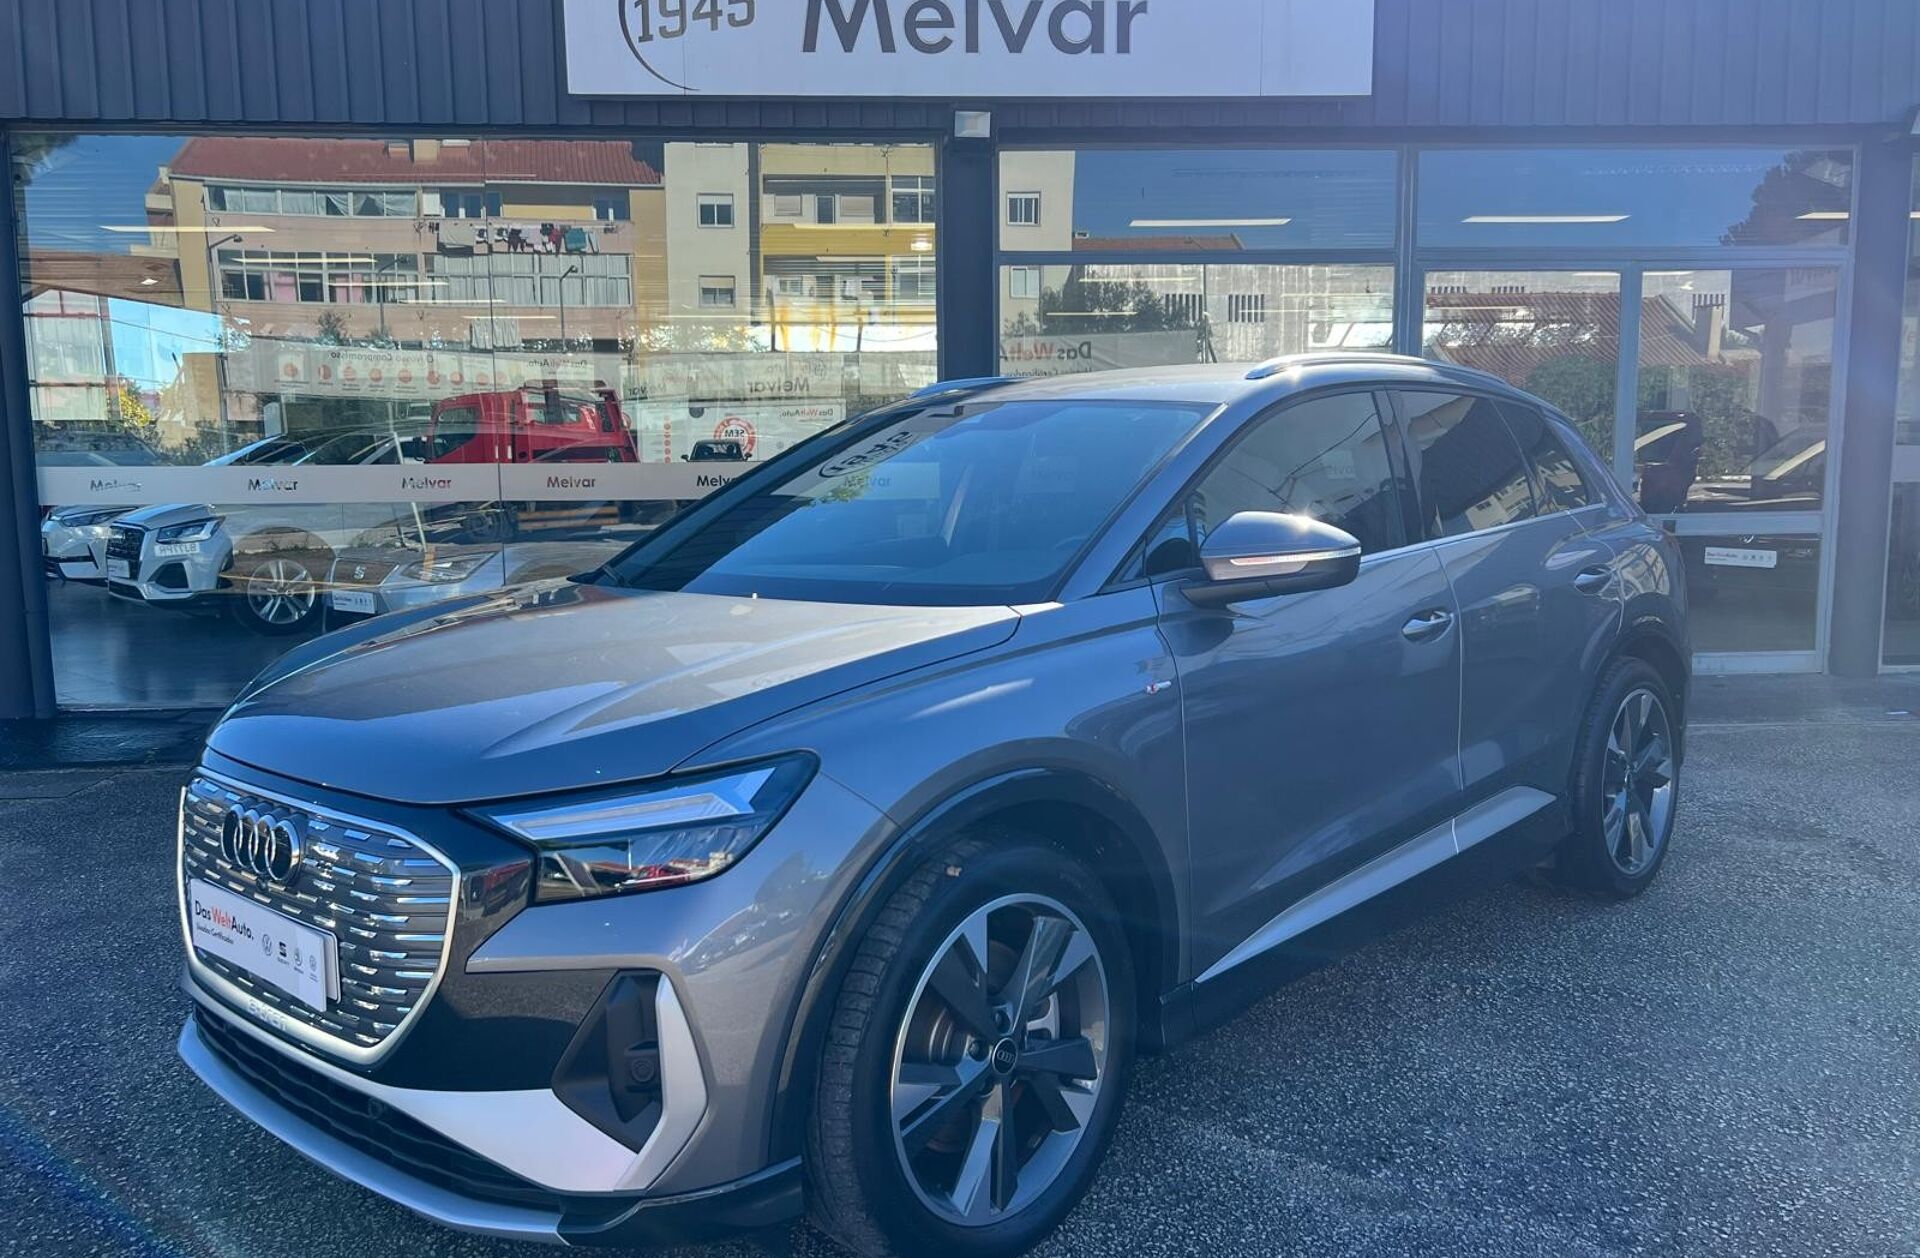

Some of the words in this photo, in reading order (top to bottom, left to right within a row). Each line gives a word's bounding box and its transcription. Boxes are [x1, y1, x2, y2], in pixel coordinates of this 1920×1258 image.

[634, 0, 755, 43] 1945
[802, 0, 1148, 54] Melvar
[402, 477, 452, 489] Melvar
[546, 476, 596, 489] Melvar
[195, 899, 211, 920] Das
